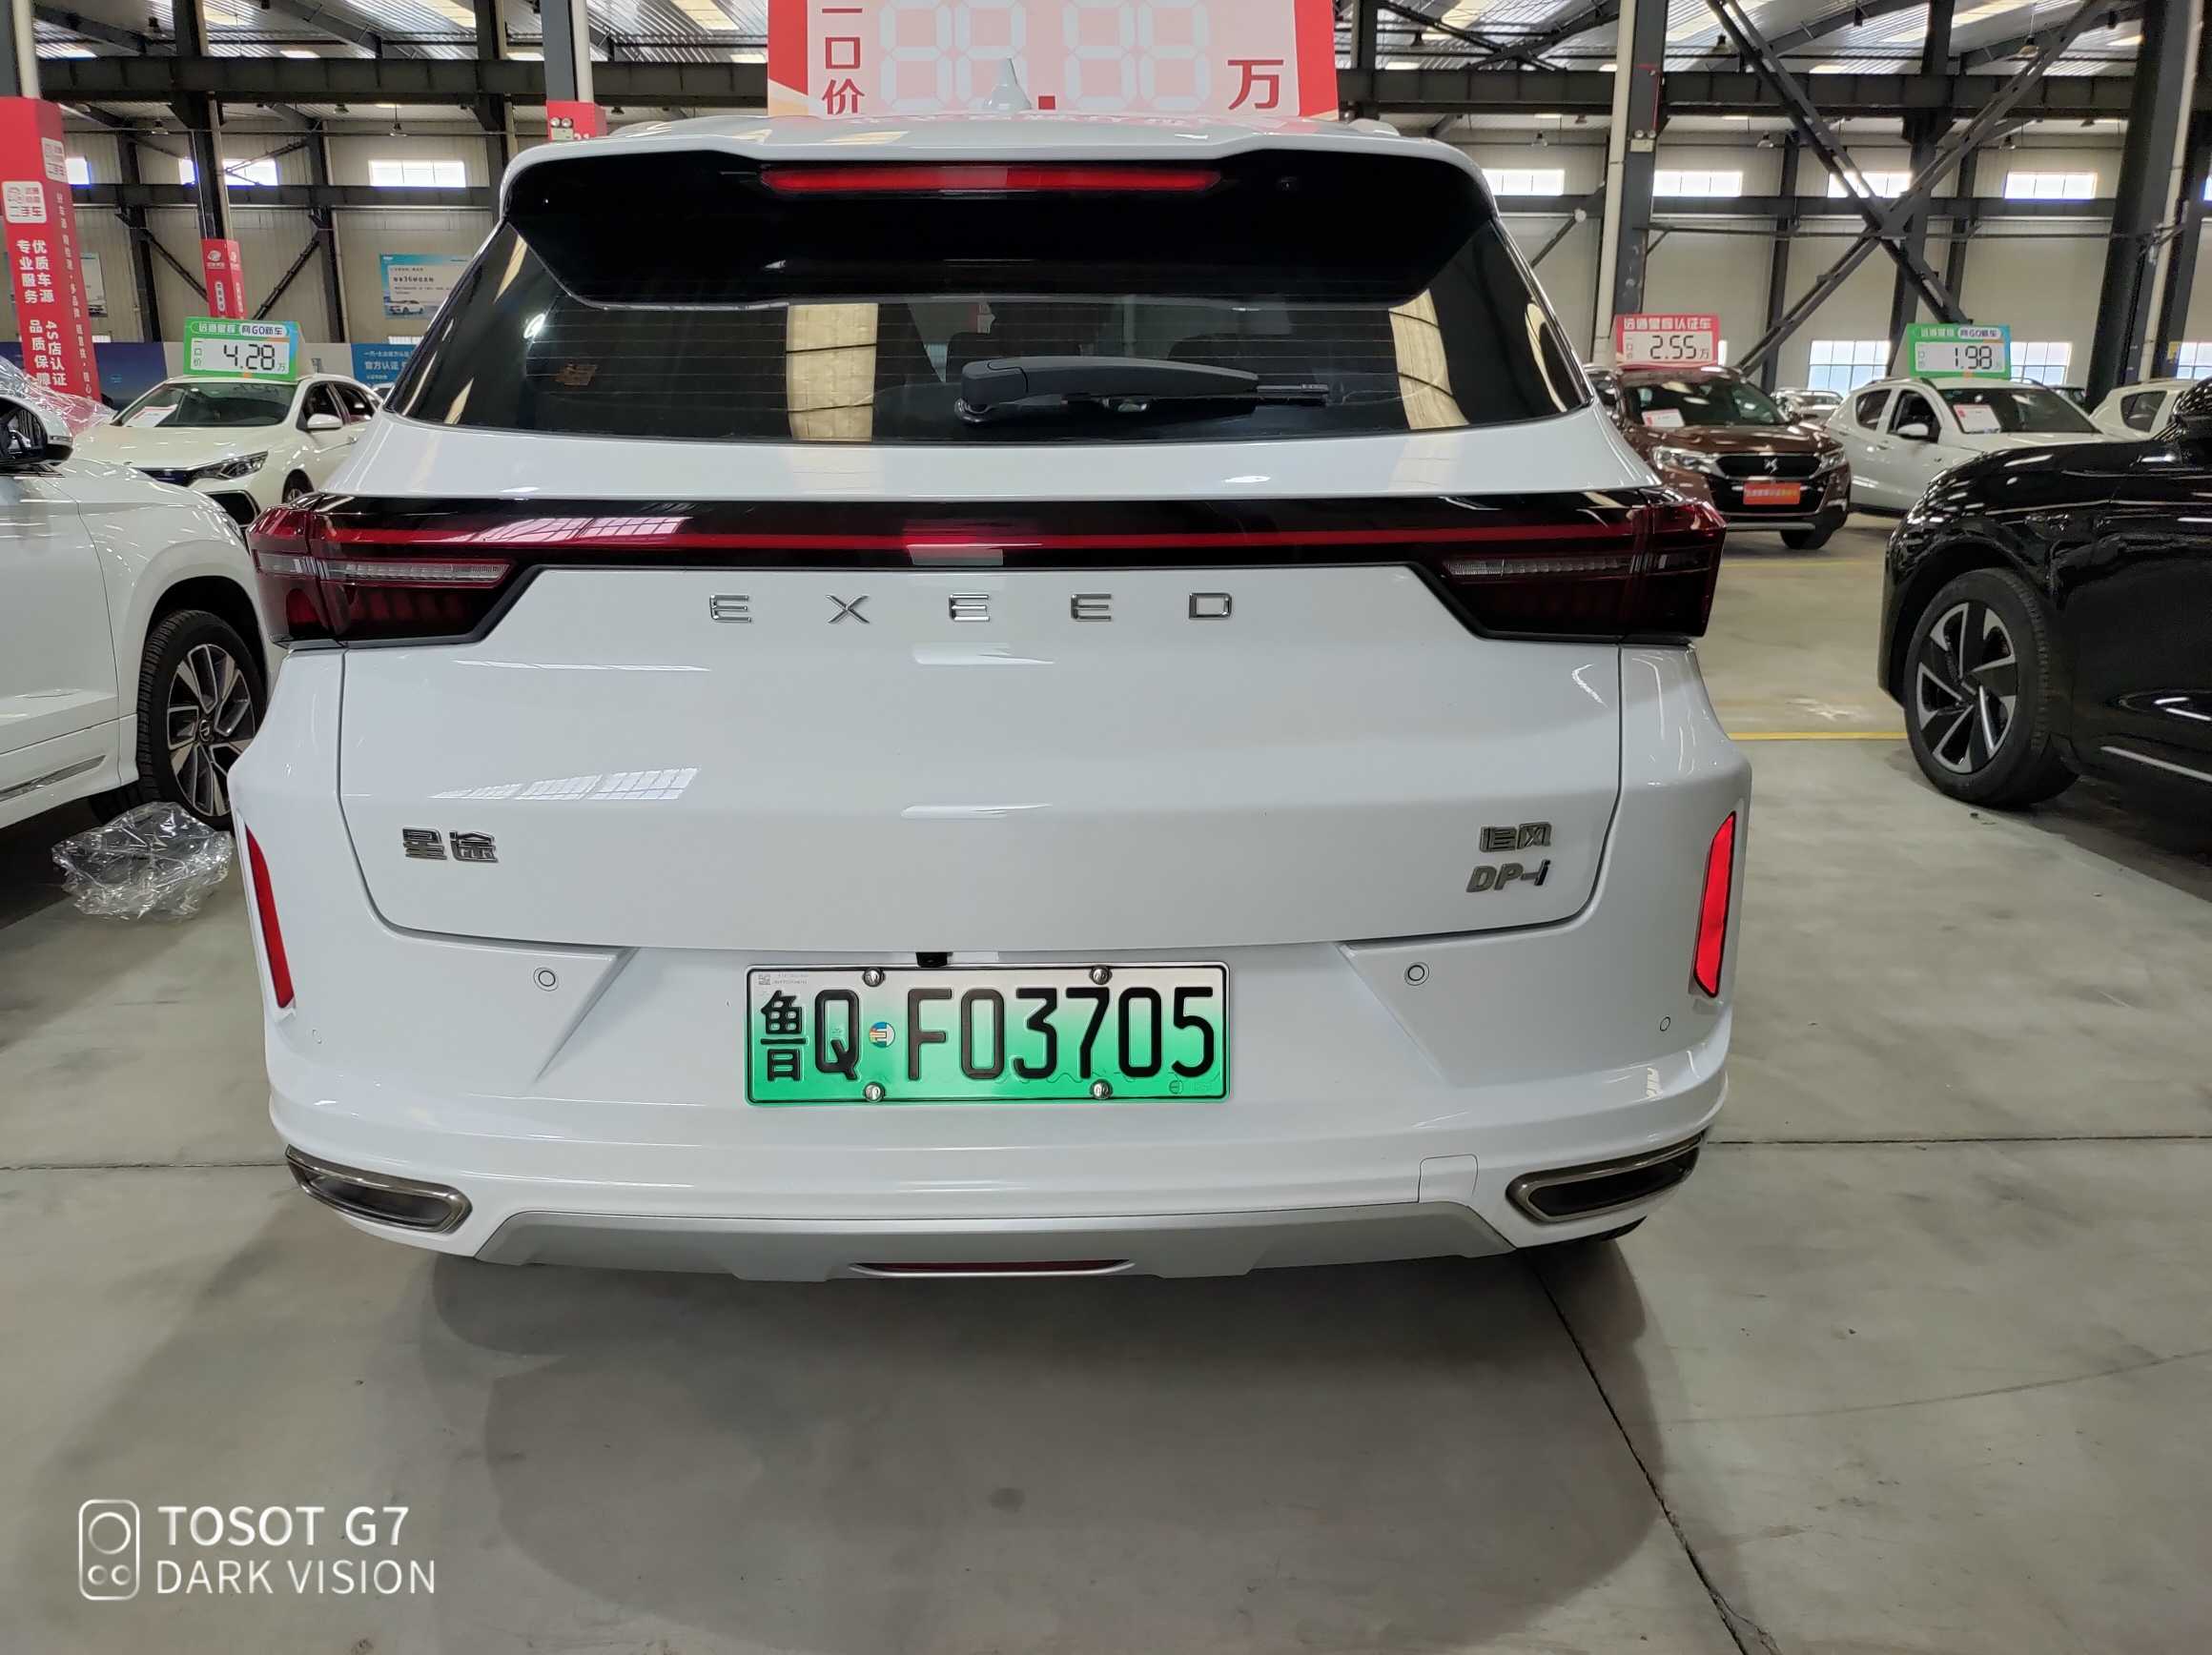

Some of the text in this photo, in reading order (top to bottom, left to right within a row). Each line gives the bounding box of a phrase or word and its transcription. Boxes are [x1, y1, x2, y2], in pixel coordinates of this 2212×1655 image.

[822, 7, 865, 115] 一口价
[1227, 59, 1284, 111] 万
[16, 239, 39, 304] 专业服务
[32, 239, 55, 303] 优质车源
[46, 320, 68, 386] 4S店认证
[223, 344, 275, 371] 4.28
[1650, 336, 1696, 359] 2.55
[1955, 346, 1993, 370] 1.98
[709, 593, 1234, 623] EXEED
[402, 826, 500, 864] 星途
